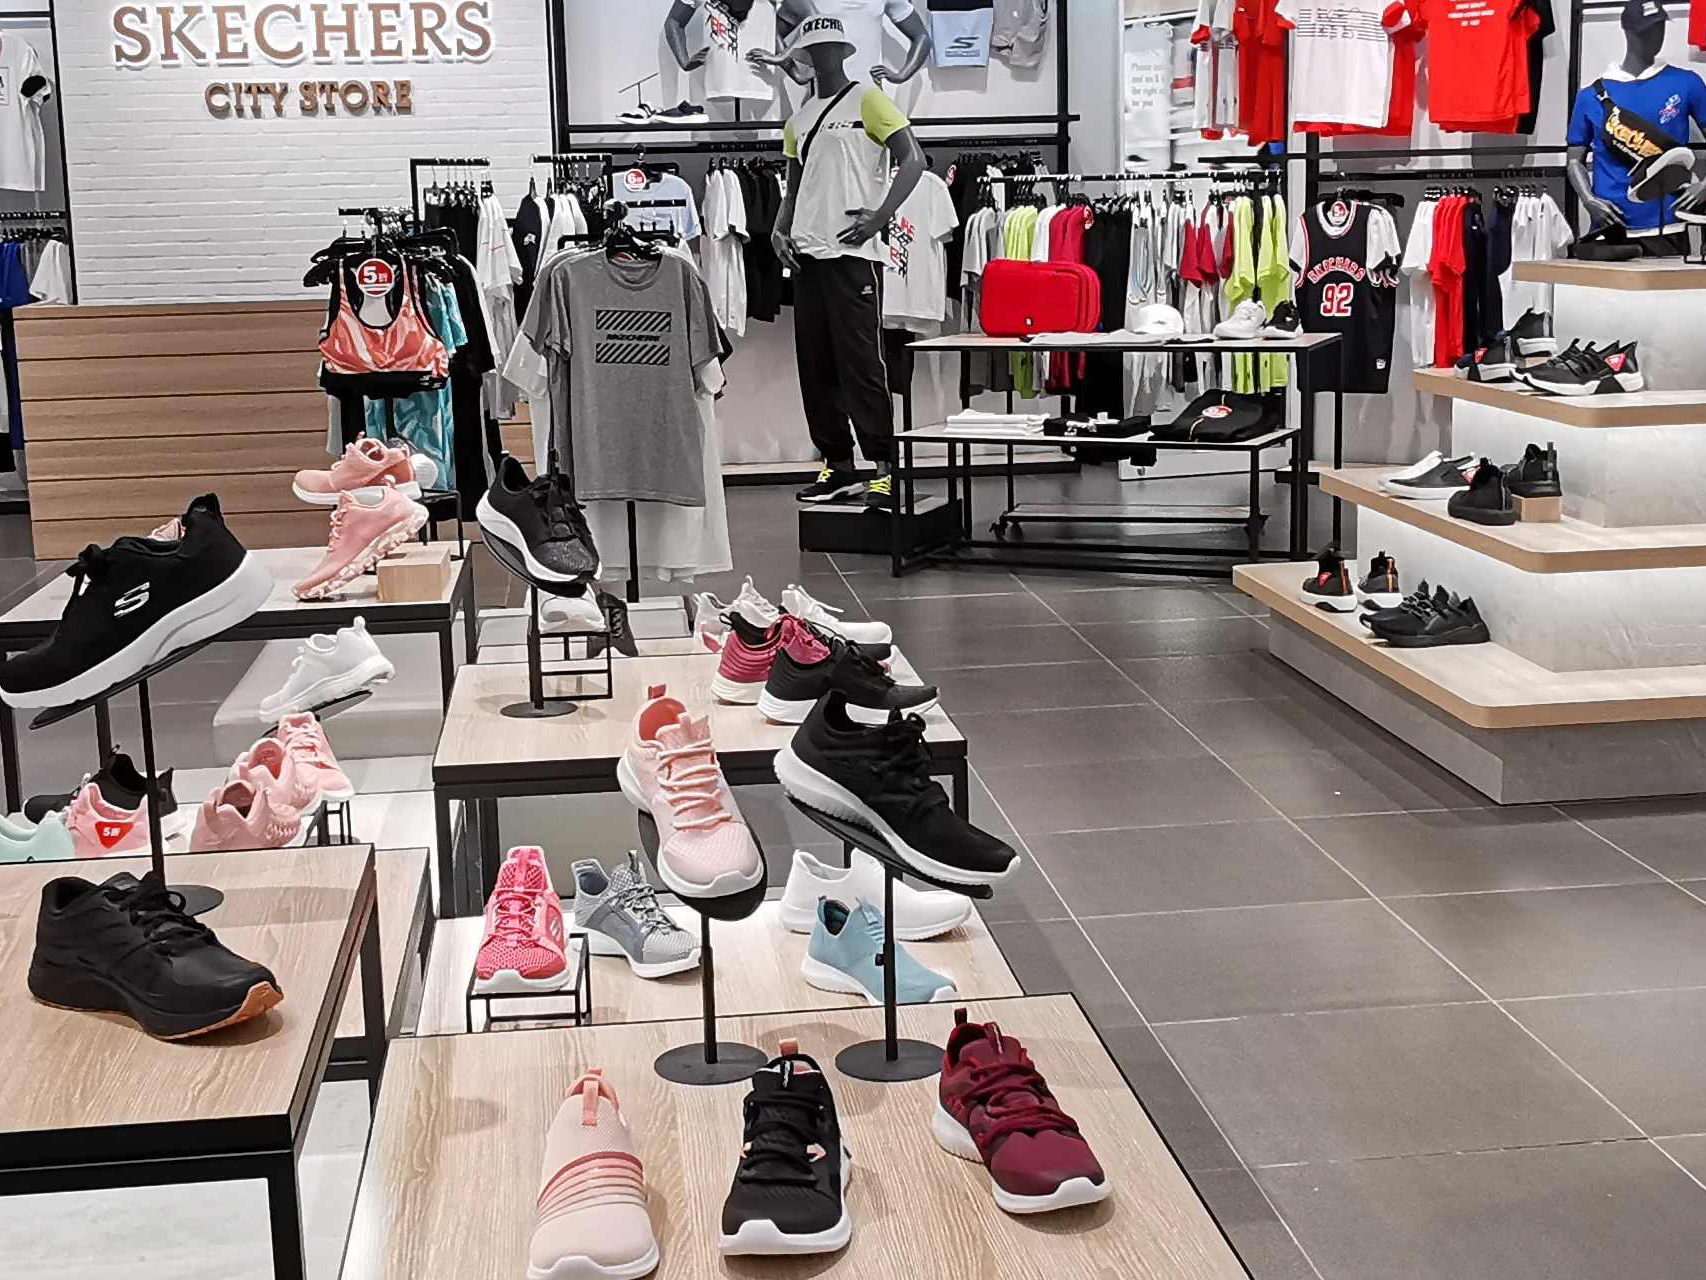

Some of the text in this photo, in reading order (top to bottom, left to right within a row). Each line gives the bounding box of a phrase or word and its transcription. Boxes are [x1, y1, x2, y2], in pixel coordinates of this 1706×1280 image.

[111, 0, 495, 65] SKECHERS
[204, 80, 412, 119] CITY STORE
[1321, 283, 1353, 317] 92
